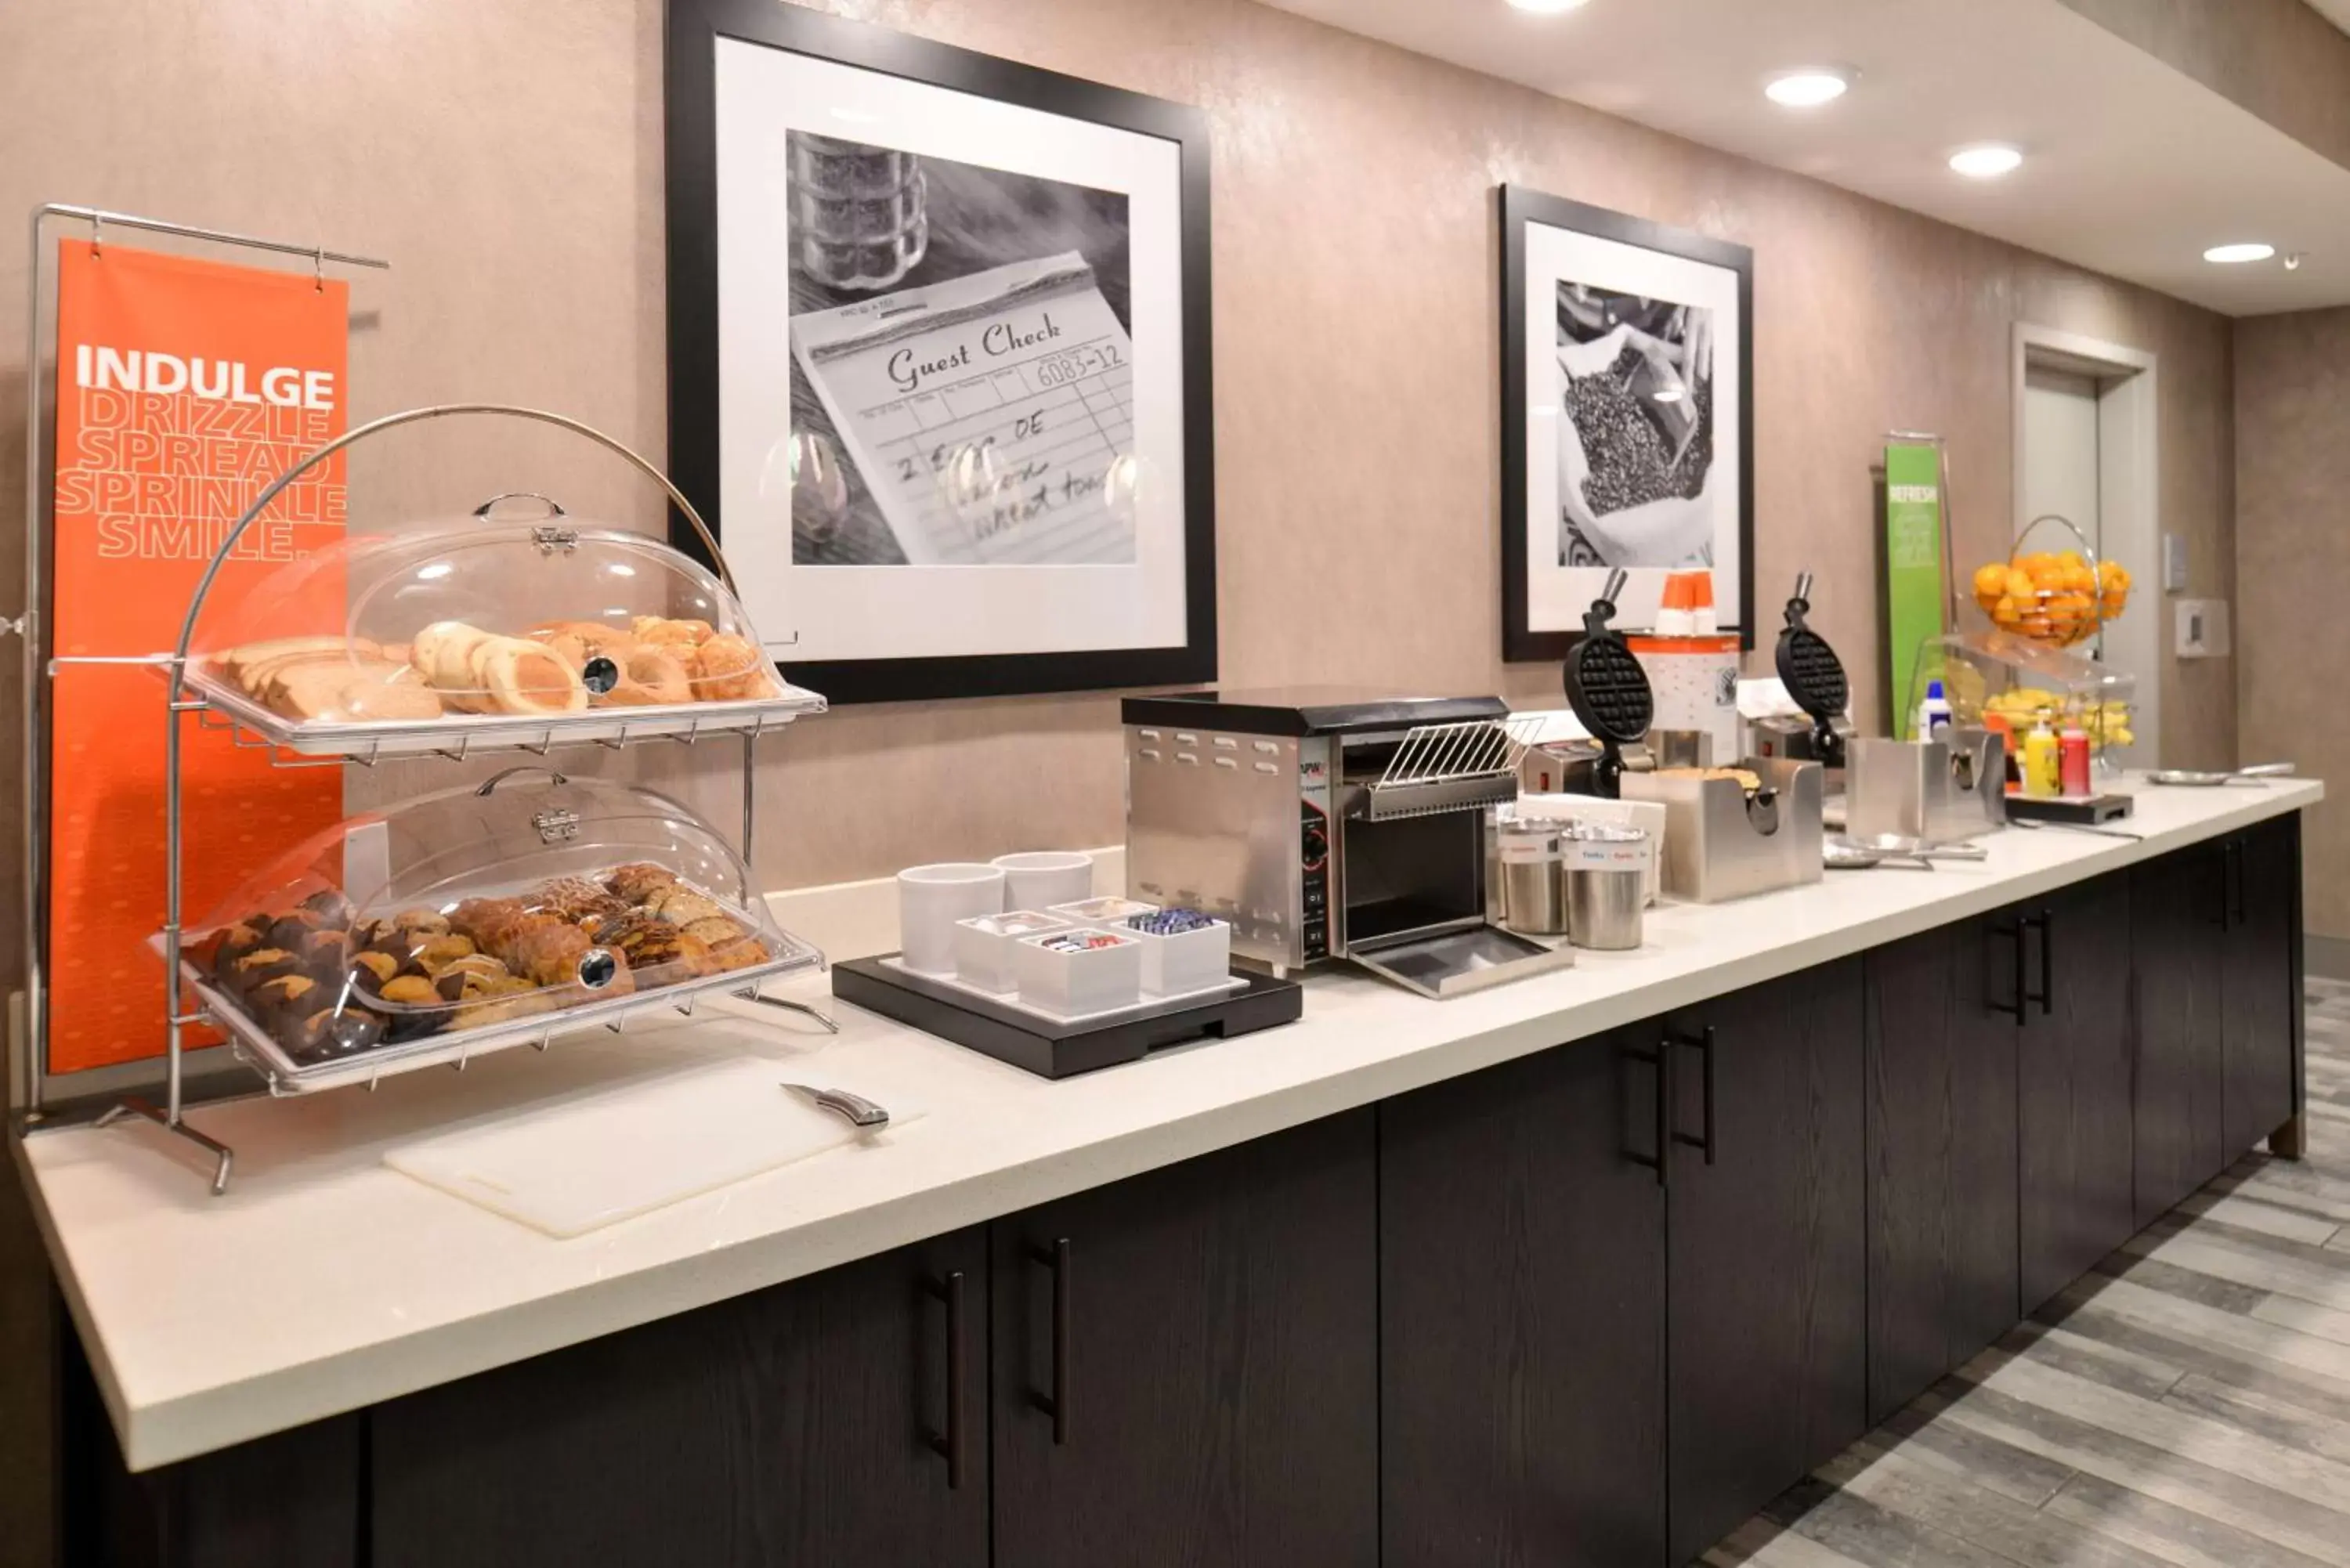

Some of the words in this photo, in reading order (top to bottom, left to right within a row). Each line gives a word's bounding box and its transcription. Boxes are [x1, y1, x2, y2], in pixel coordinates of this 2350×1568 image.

[76, 345, 334, 410] INDULGE
[888, 345, 970, 392] Guest
[982, 313, 1061, 356] Check
[1038, 345, 1123, 386] 6083-12
[80, 385, 330, 445] DRIZZLE
[78, 427, 331, 486] SPREAD
[55, 467, 347, 526] SPRINKLE
